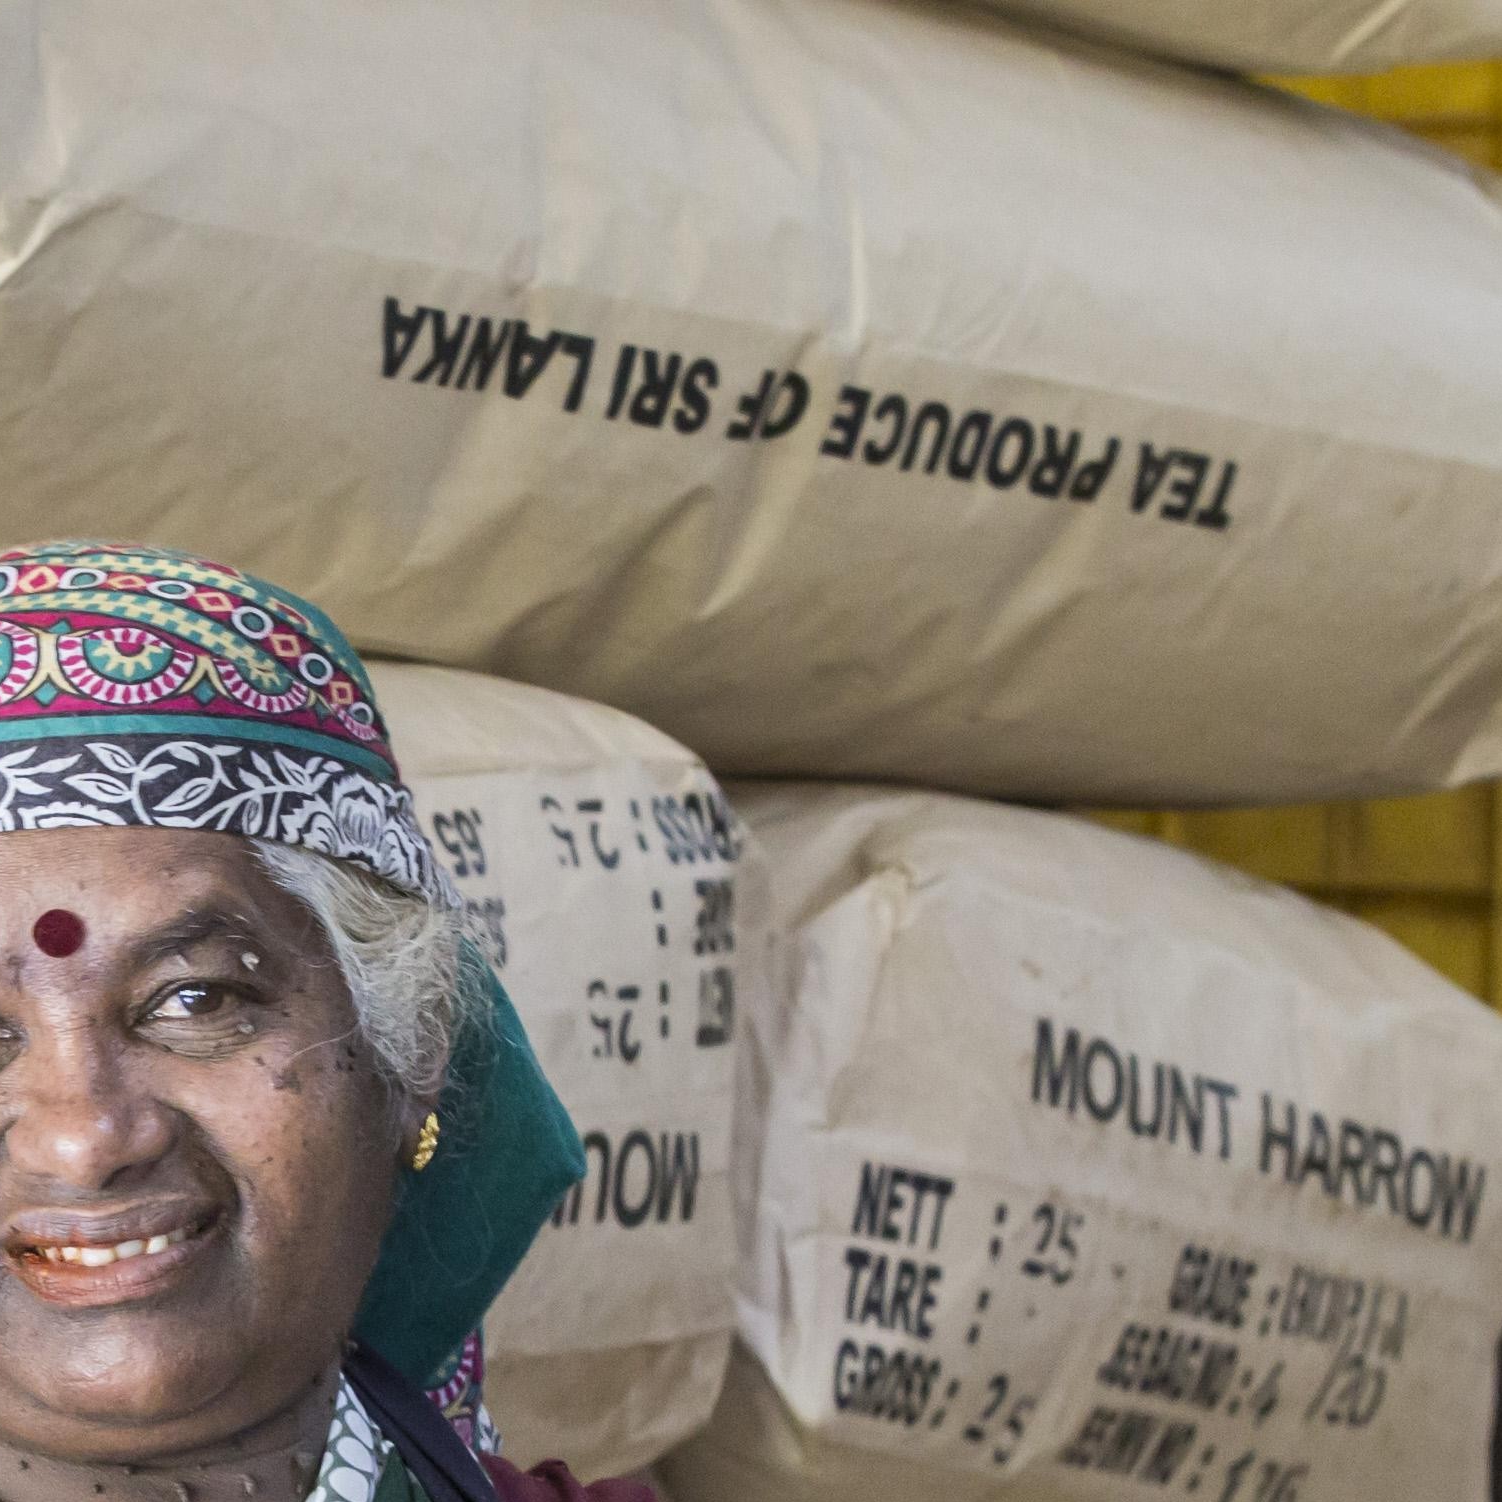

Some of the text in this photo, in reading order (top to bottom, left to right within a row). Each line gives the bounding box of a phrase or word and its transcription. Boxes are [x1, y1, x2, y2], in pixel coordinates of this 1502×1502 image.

[379, 294, 597, 414] LANKA
[604, 343, 721, 434] SRI
[820, 383, 1123, 504] PRODUCE
[1130, 440, 1238, 531] TEA
[551, 1130, 698, 1228] MOU
[1029, 1016, 1487, 1247] MOUNT HARROW
[851, 1160, 955, 1250] NETT
[1020, 1202, 1086, 1287] 25
[844, 1246, 942, 1341] TARE
[962, 1373, 1037, 1464] 25
